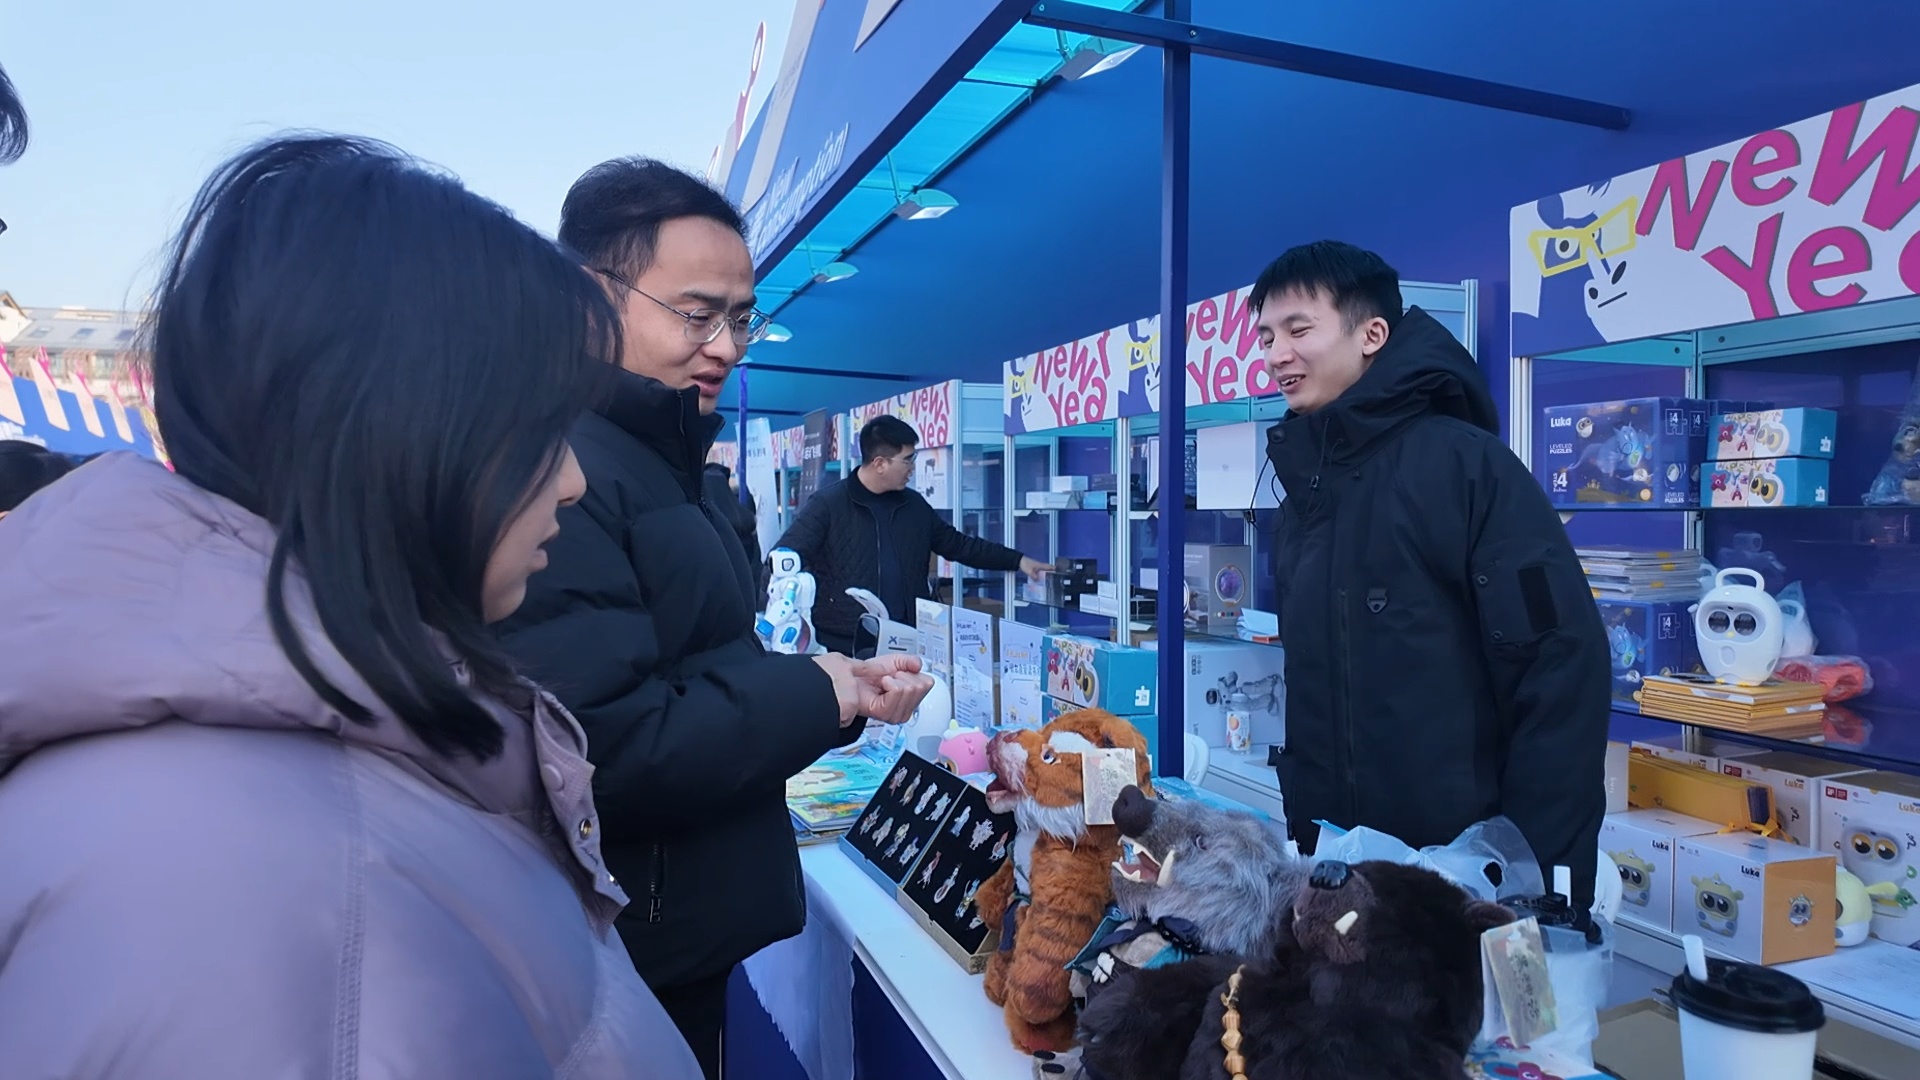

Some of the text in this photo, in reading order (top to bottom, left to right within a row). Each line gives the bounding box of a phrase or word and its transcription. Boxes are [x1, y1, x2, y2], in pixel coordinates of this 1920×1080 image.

[1701, 212, 1920, 320] Ye
[1550, 417, 1572, 428] Luka
[1557, 472, 1568, 488] 4
[1784, 778, 1804, 790] Luka
[1652, 839, 1670, 852] Luka
[1741, 864, 1760, 878] Luka
